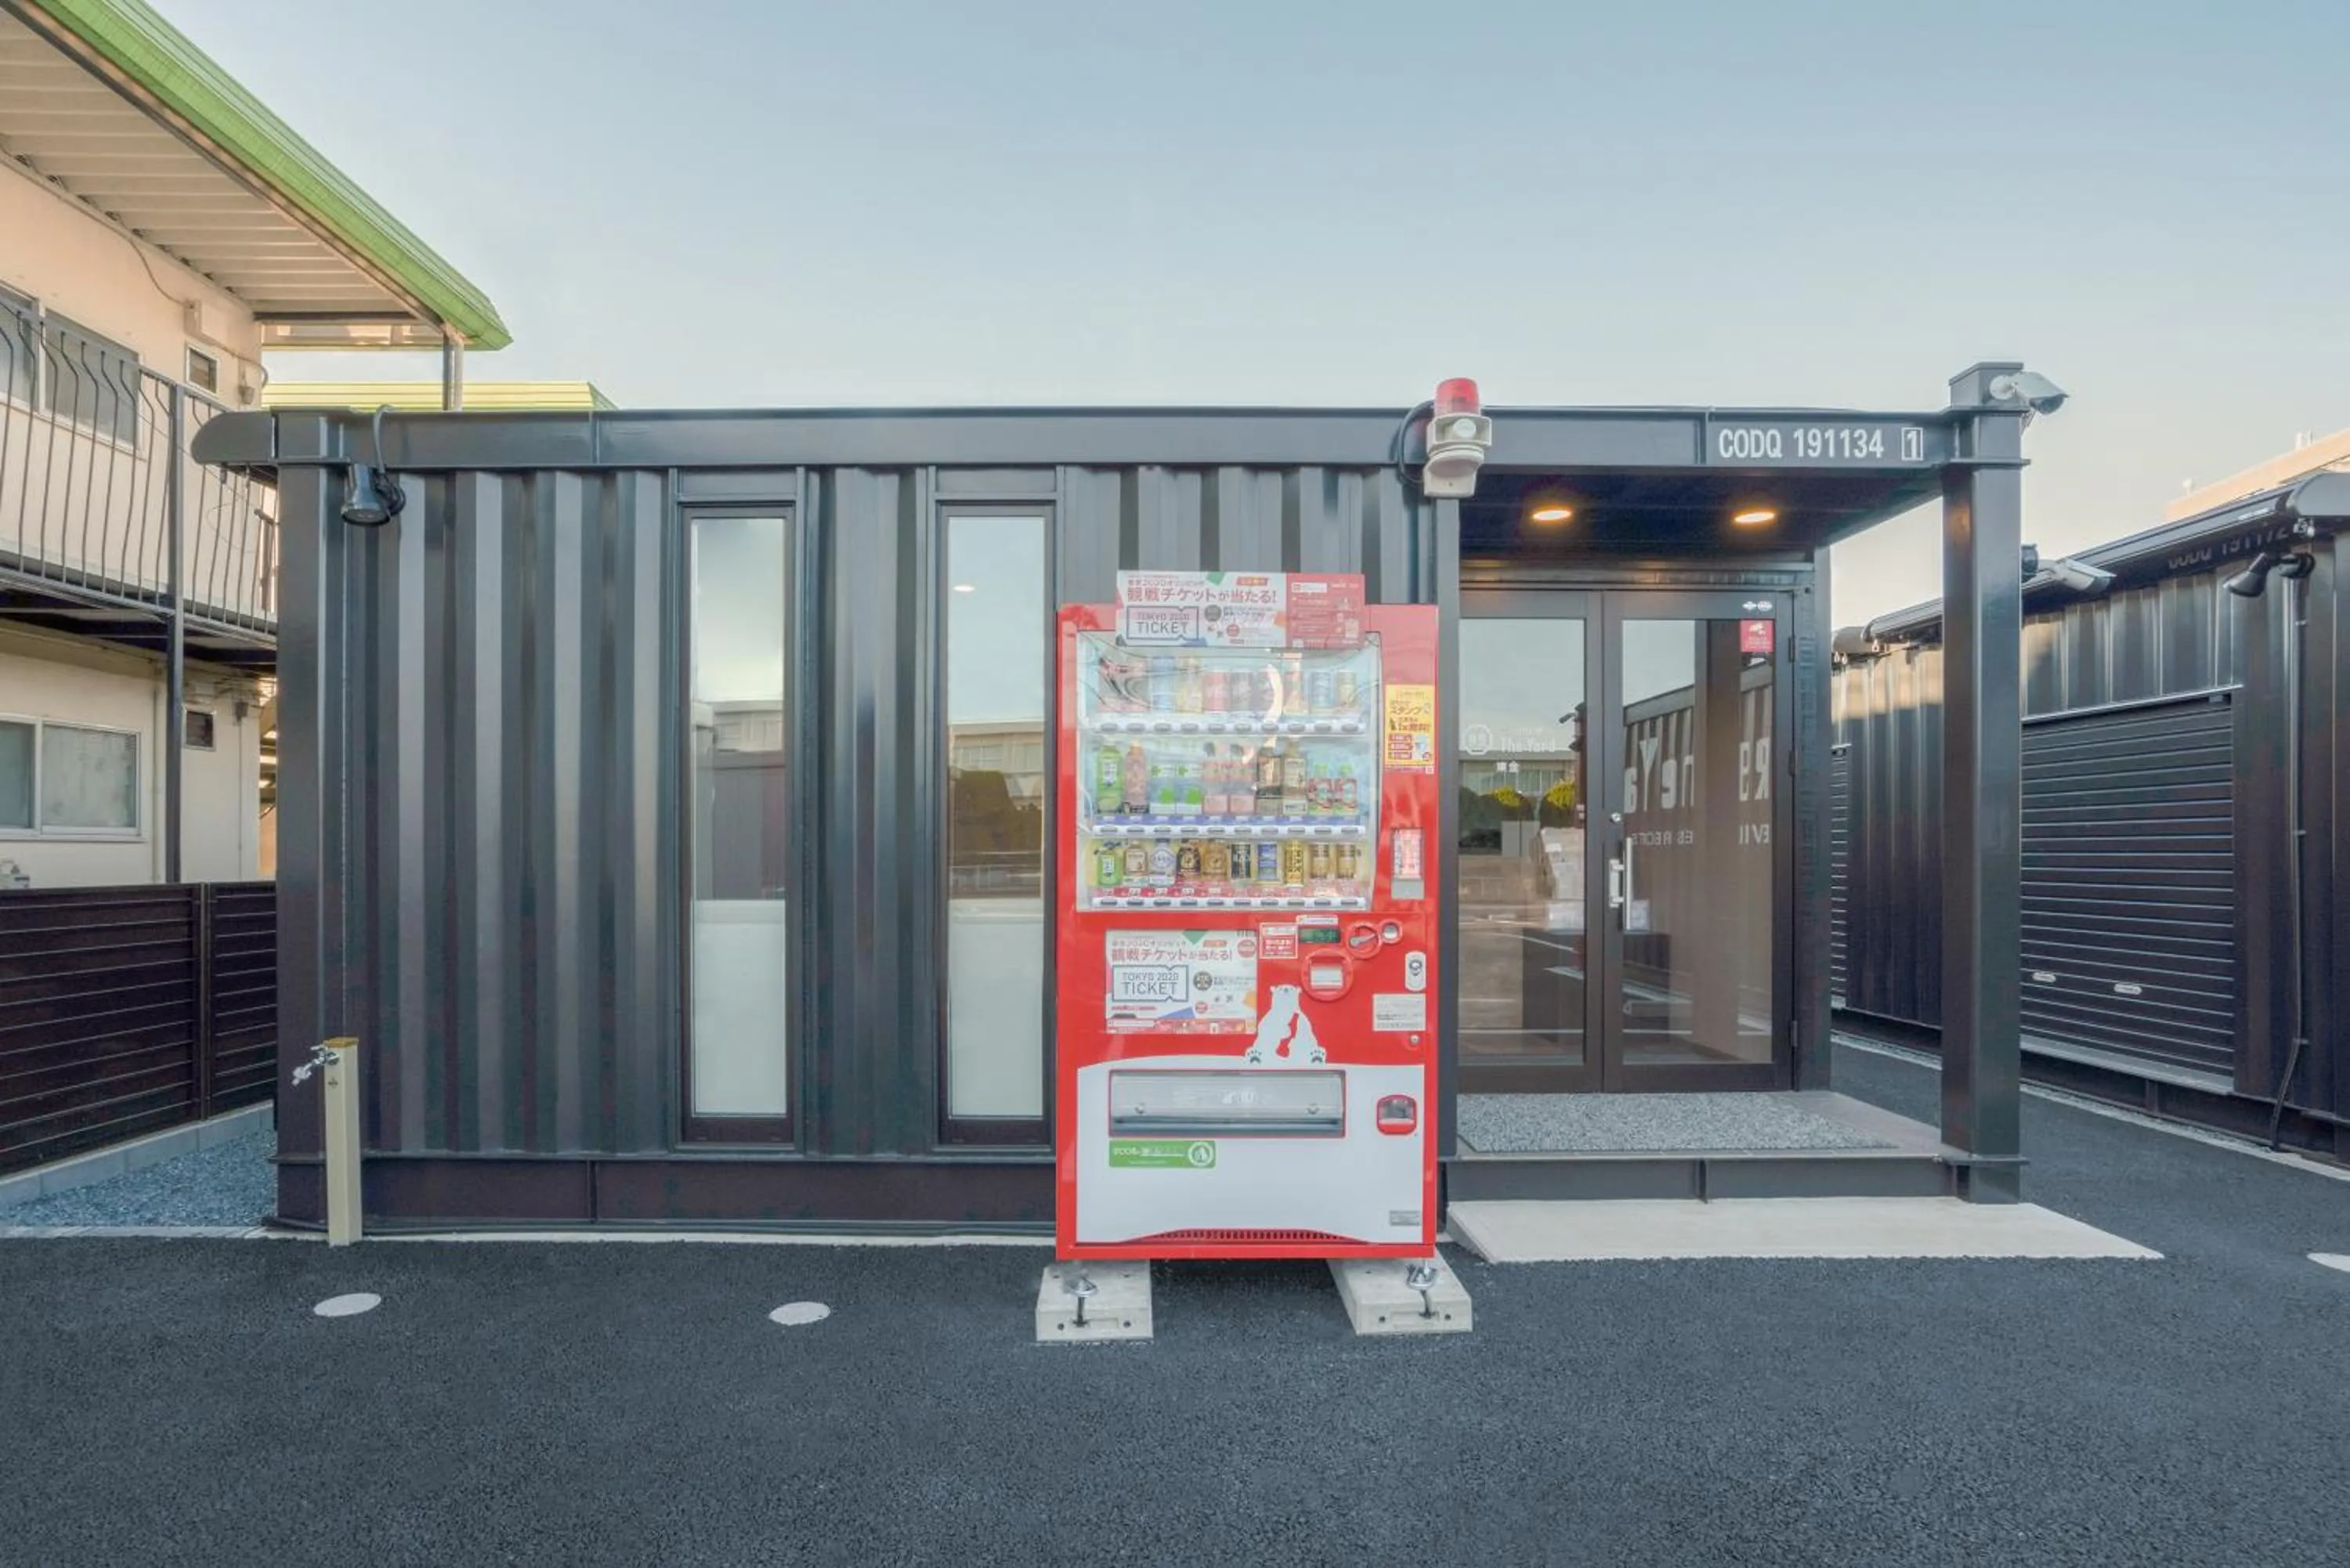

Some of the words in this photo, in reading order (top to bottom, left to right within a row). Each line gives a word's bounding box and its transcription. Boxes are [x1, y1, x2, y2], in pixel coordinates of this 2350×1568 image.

[1719, 428, 1783, 459] CODQ
[1793, 428, 1885, 459] 191134
[1905, 429, 1919, 460] 1
[1137, 621, 1190, 634] TICKET
[1122, 972, 1154, 981] TOKYO
[1157, 972, 1179, 981] 2020
[1123, 981, 1177, 995] TICKET
